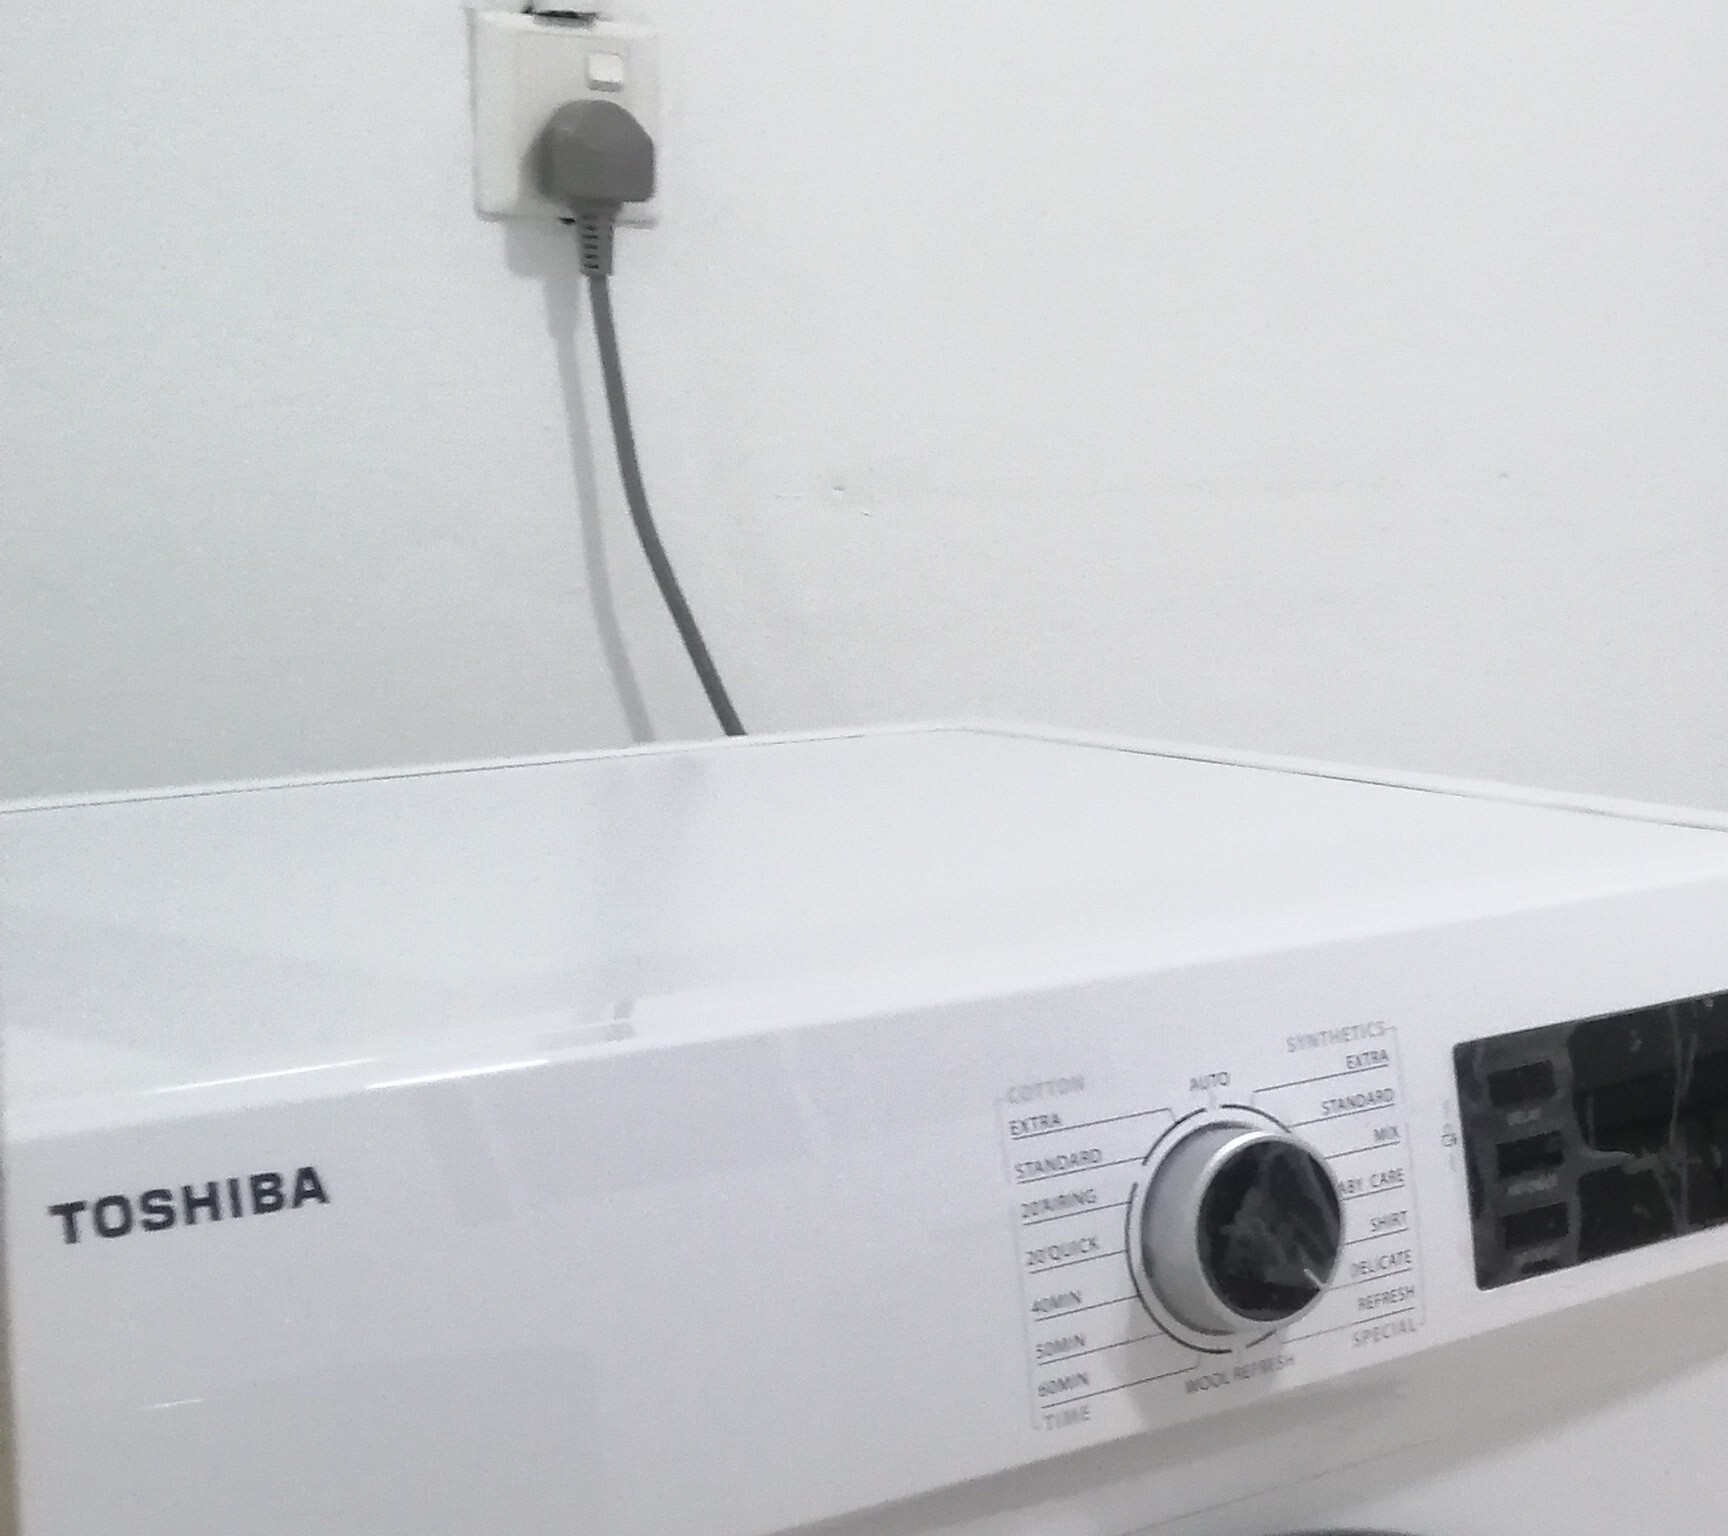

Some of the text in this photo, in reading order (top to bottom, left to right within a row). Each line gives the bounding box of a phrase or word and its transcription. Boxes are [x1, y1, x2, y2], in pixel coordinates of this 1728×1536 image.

[1286, 1021, 1385, 1052] SYNTHETICS
[1345, 1049, 1388, 1069] EXTRA
[1007, 1074, 1084, 1104] COTTON
[1189, 1071, 1231, 1091] AUTO
[1321, 1087, 1395, 1114] STANDARD
[1008, 1113, 1062, 1136] EXTRA
[1374, 1125, 1400, 1142] MIX
[1014, 1148, 1102, 1179] STANDARD
[1337, 1168, 1404, 1194] ABY CARE
[48, 1165, 330, 1244] TOSHIBA
[1370, 1210, 1407, 1233] SHIRT
[1358, 1285, 1415, 1311] REFRESH
[1352, 1319, 1416, 1347] SPECIAL
[1043, 1405, 1090, 1431] TIME
